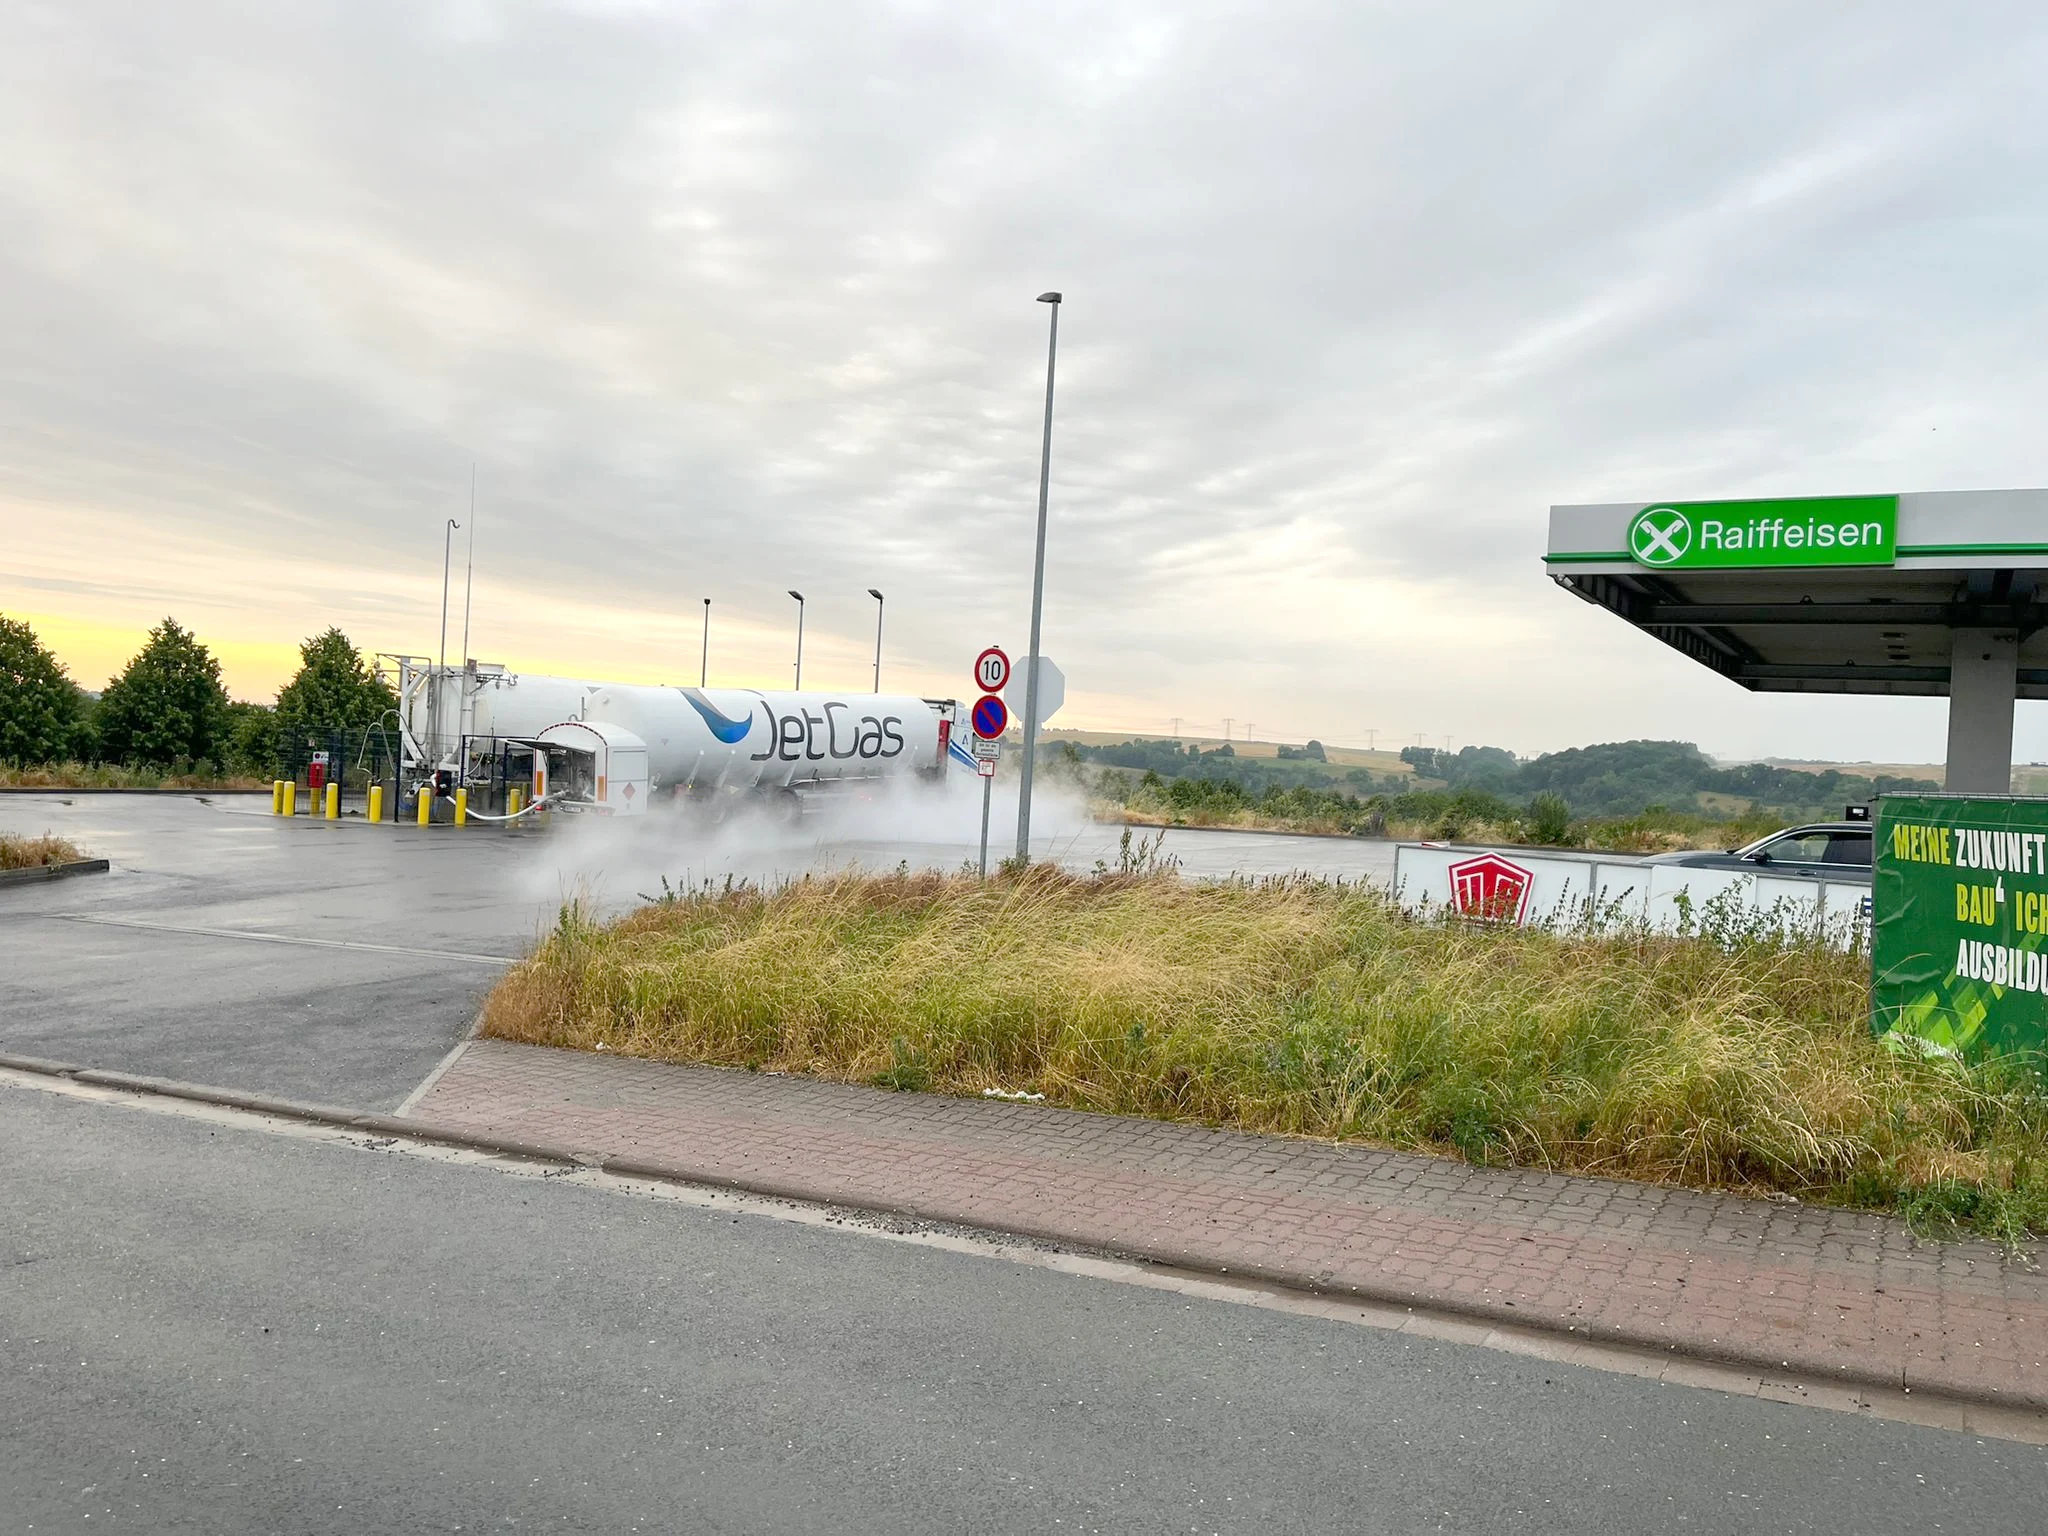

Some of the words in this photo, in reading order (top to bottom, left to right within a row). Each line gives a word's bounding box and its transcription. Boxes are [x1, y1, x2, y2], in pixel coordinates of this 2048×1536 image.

[1700, 517, 1883, 550] Raiffeisen
[983, 660, 1001, 681] 10
[750, 700, 905, 762] JetGas
[1893, 823, 1951, 865] MEINE
[1954, 828, 2046, 875] ZUKUNFT
